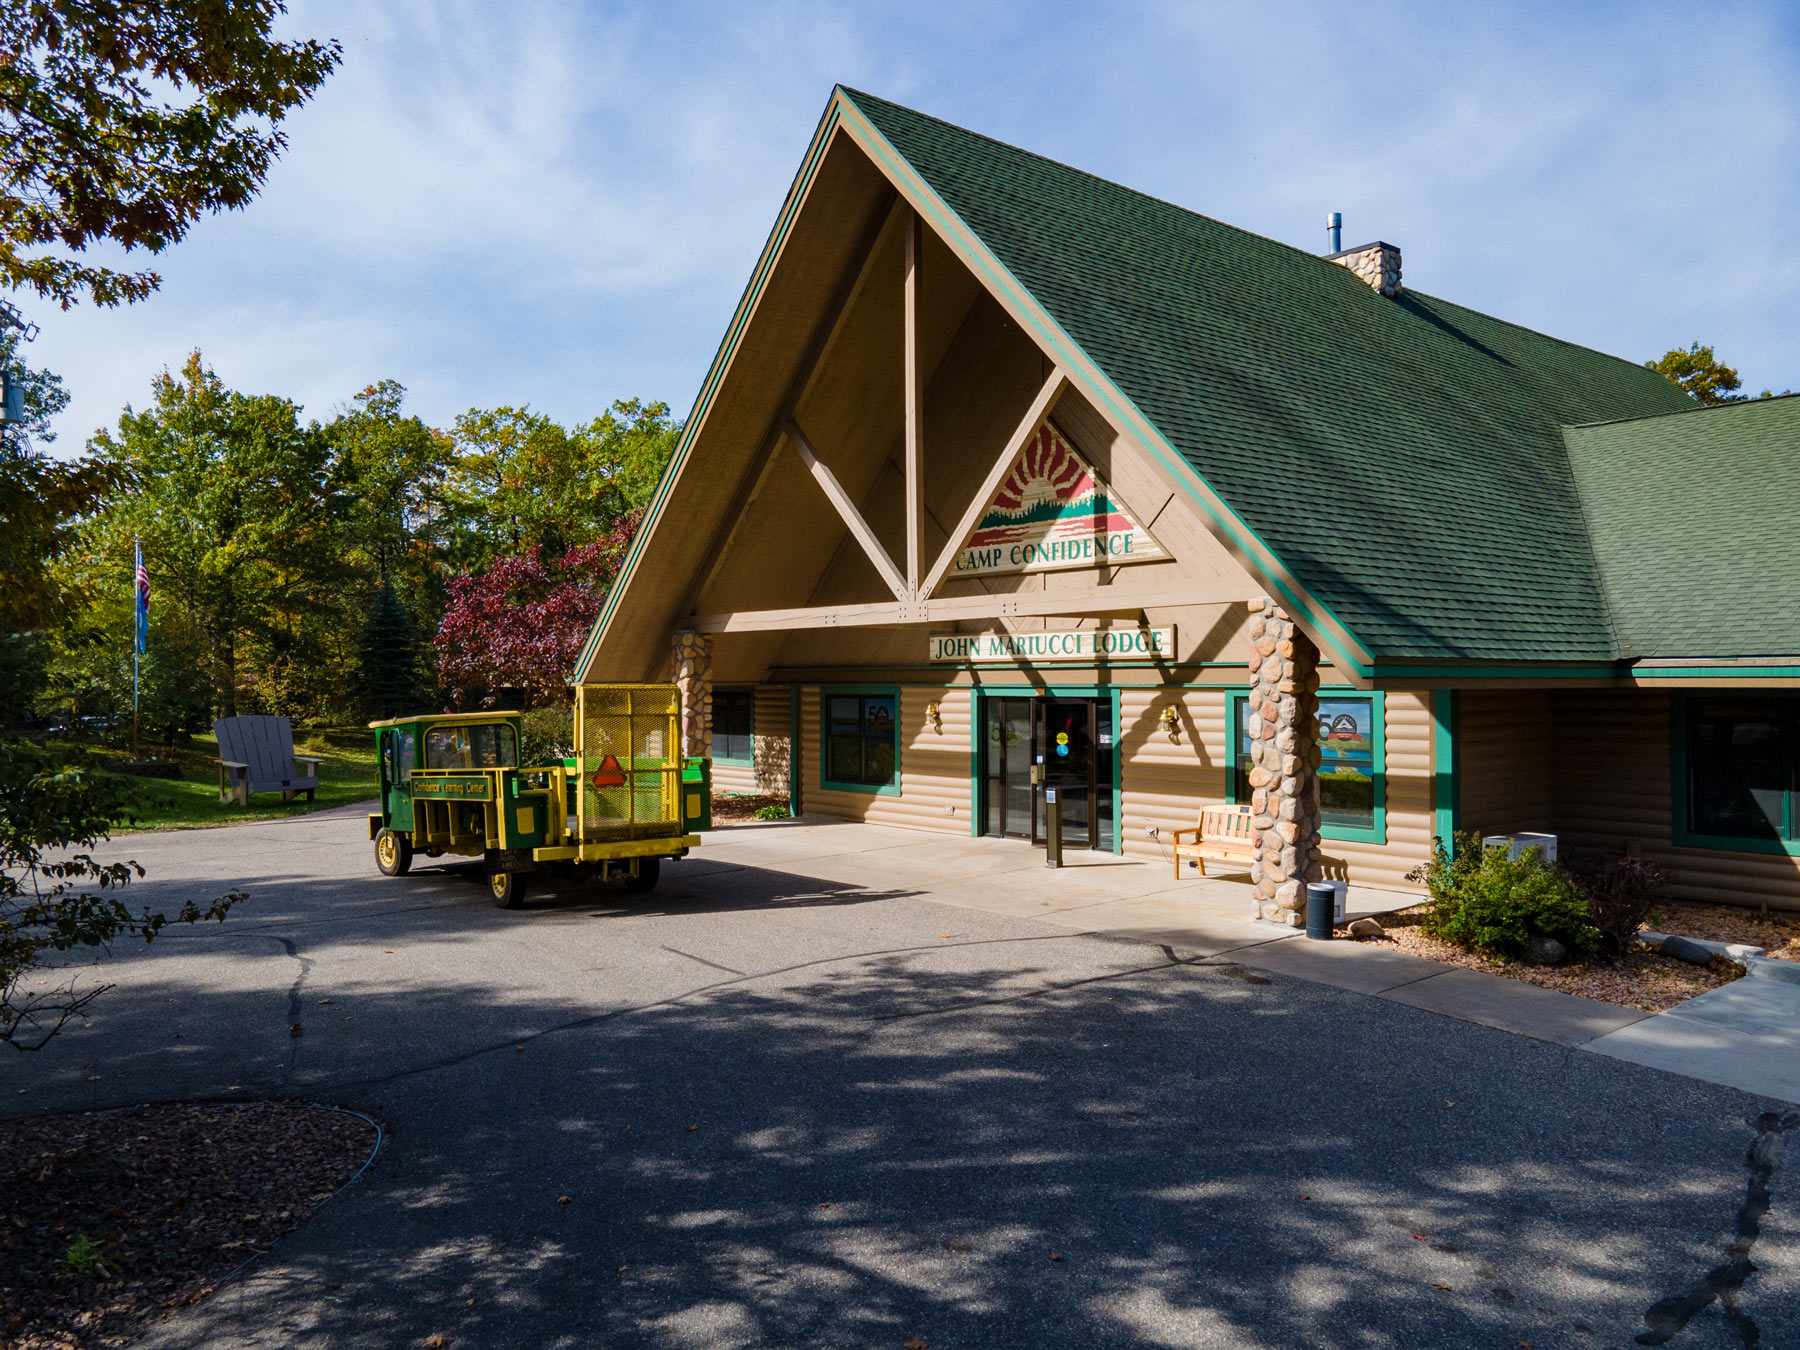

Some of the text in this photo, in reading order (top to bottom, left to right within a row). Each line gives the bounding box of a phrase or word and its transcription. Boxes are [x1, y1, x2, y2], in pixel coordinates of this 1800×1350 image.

[956, 533, 1134, 571] CAMP CONFIDENCE
[935, 631, 1163, 660] JOHN MARIUCCI LODGE
[415, 782, 441, 793] Confidence
[466, 782, 485, 793] Center
